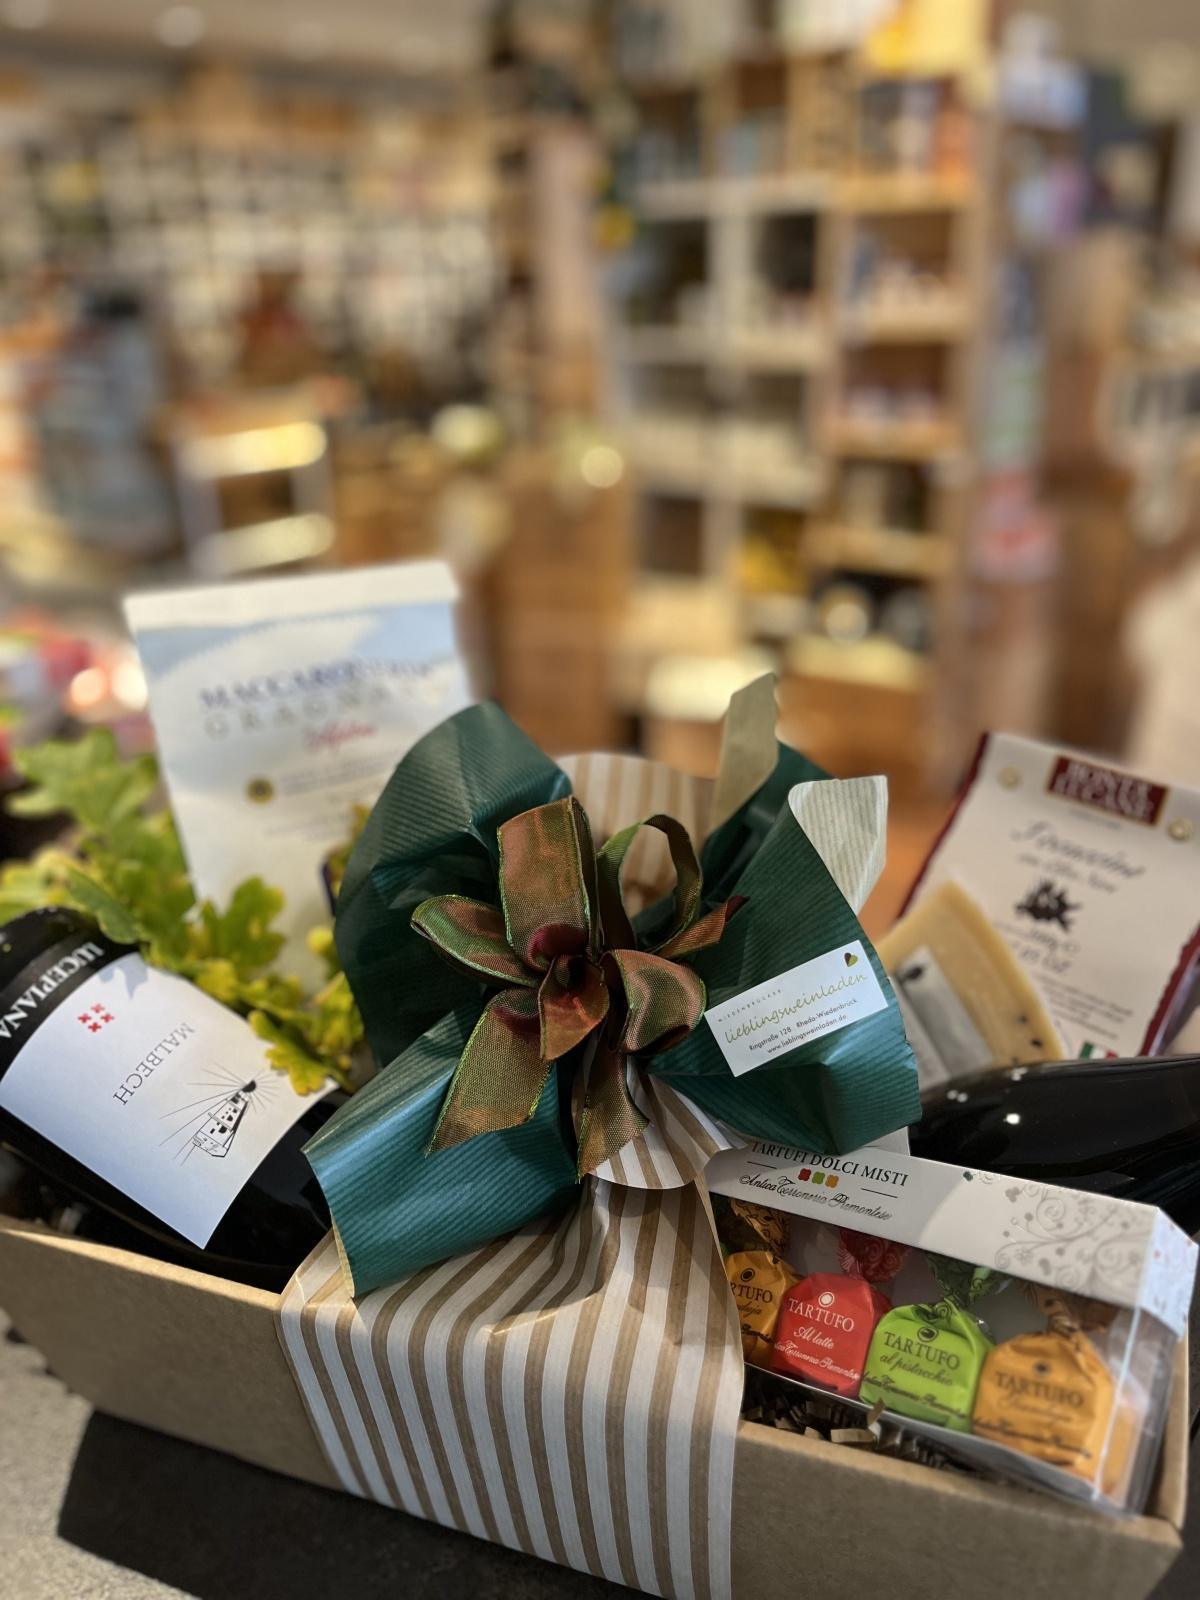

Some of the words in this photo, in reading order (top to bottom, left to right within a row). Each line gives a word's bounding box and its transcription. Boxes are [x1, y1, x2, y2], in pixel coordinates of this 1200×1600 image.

[725, 973, 868, 1043] lieblingsweinladen
[113, 1022, 196, 1105] MALBECH
[751, 1141, 806, 1164] TARTUFI
[809, 1153, 859, 1176] DOLCI
[860, 1165, 910, 1187] MISTI
[739, 1173, 777, 1191] Antica
[731, 1282, 773, 1304] RTUFO
[788, 1298, 855, 1332] TARTUFO
[812, 1331, 835, 1350] latte
[884, 1331, 960, 1370] TARTUFO
[880, 1352, 900, 1364] al
[889, 1357, 953, 1386] pistacchio
[995, 1370, 1085, 1407] TARTUFO
